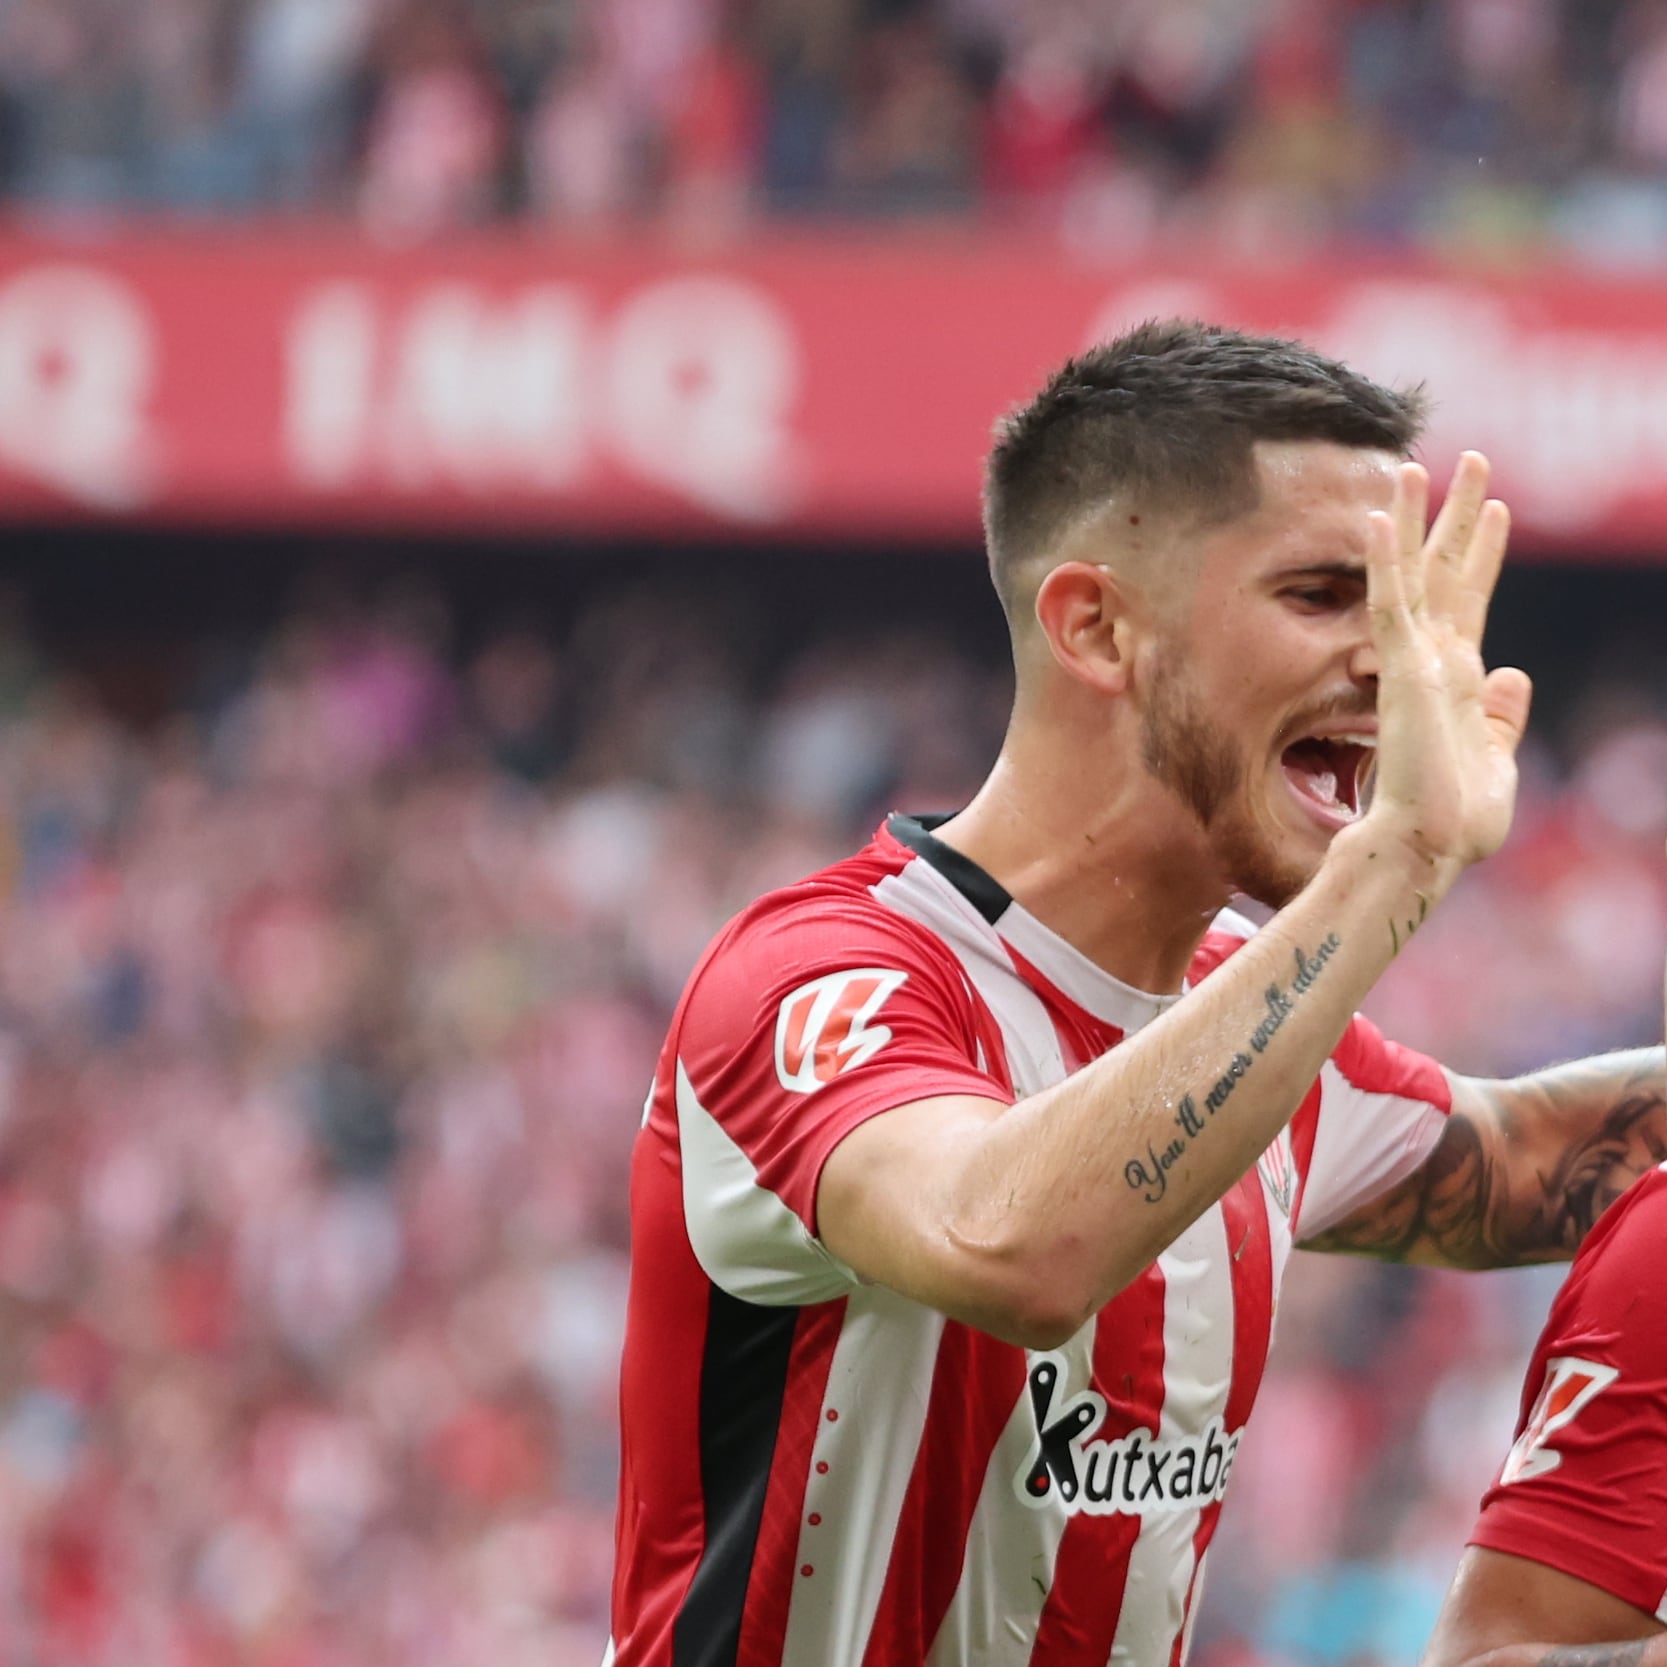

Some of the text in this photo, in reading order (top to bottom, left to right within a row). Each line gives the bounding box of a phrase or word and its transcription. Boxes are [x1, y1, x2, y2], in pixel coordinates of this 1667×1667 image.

[1124, 932, 1341, 1204] You'll never walk alone
